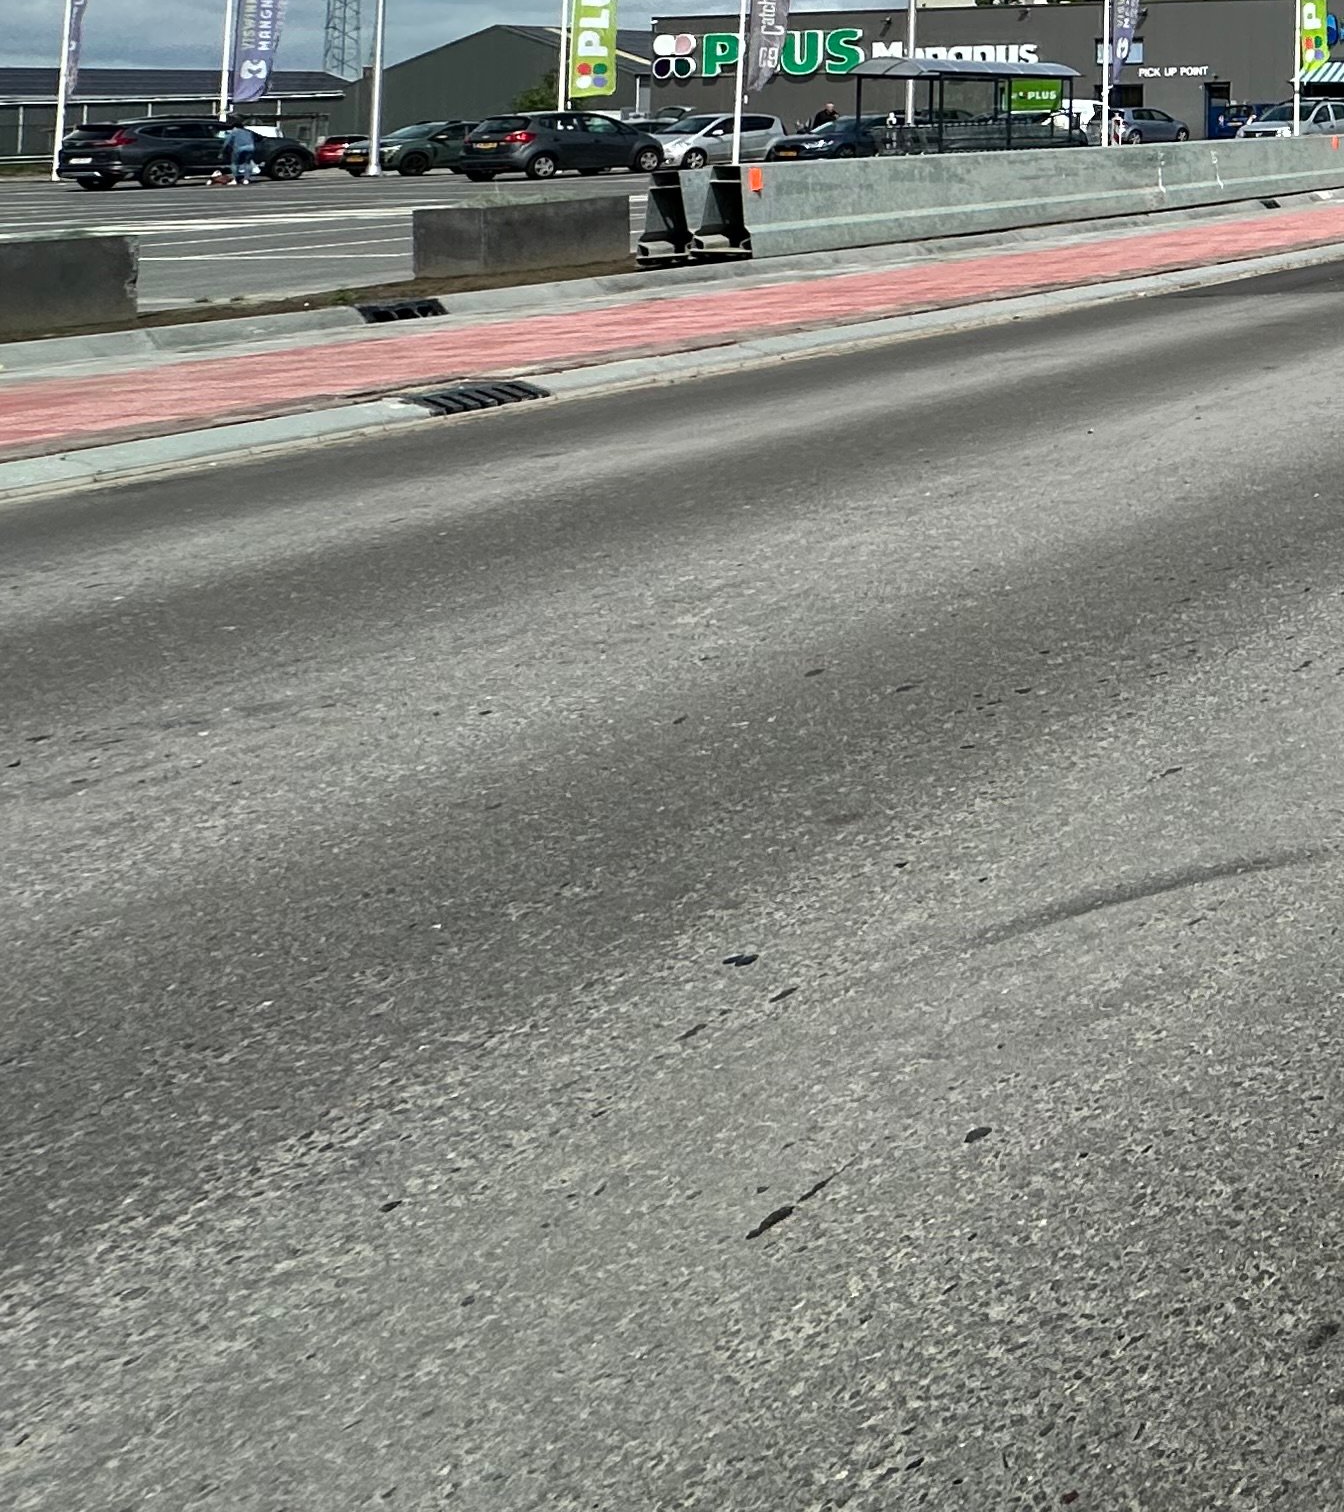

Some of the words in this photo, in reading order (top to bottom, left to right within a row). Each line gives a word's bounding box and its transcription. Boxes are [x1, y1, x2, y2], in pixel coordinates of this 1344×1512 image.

[702, 28, 867, 77] PUS
[1138, 67, 1162, 78] PICK
[1163, 66, 1178, 77] UP
[1179, 65, 1209, 76] POINT
[1027, 90, 1057, 100] PLUS
